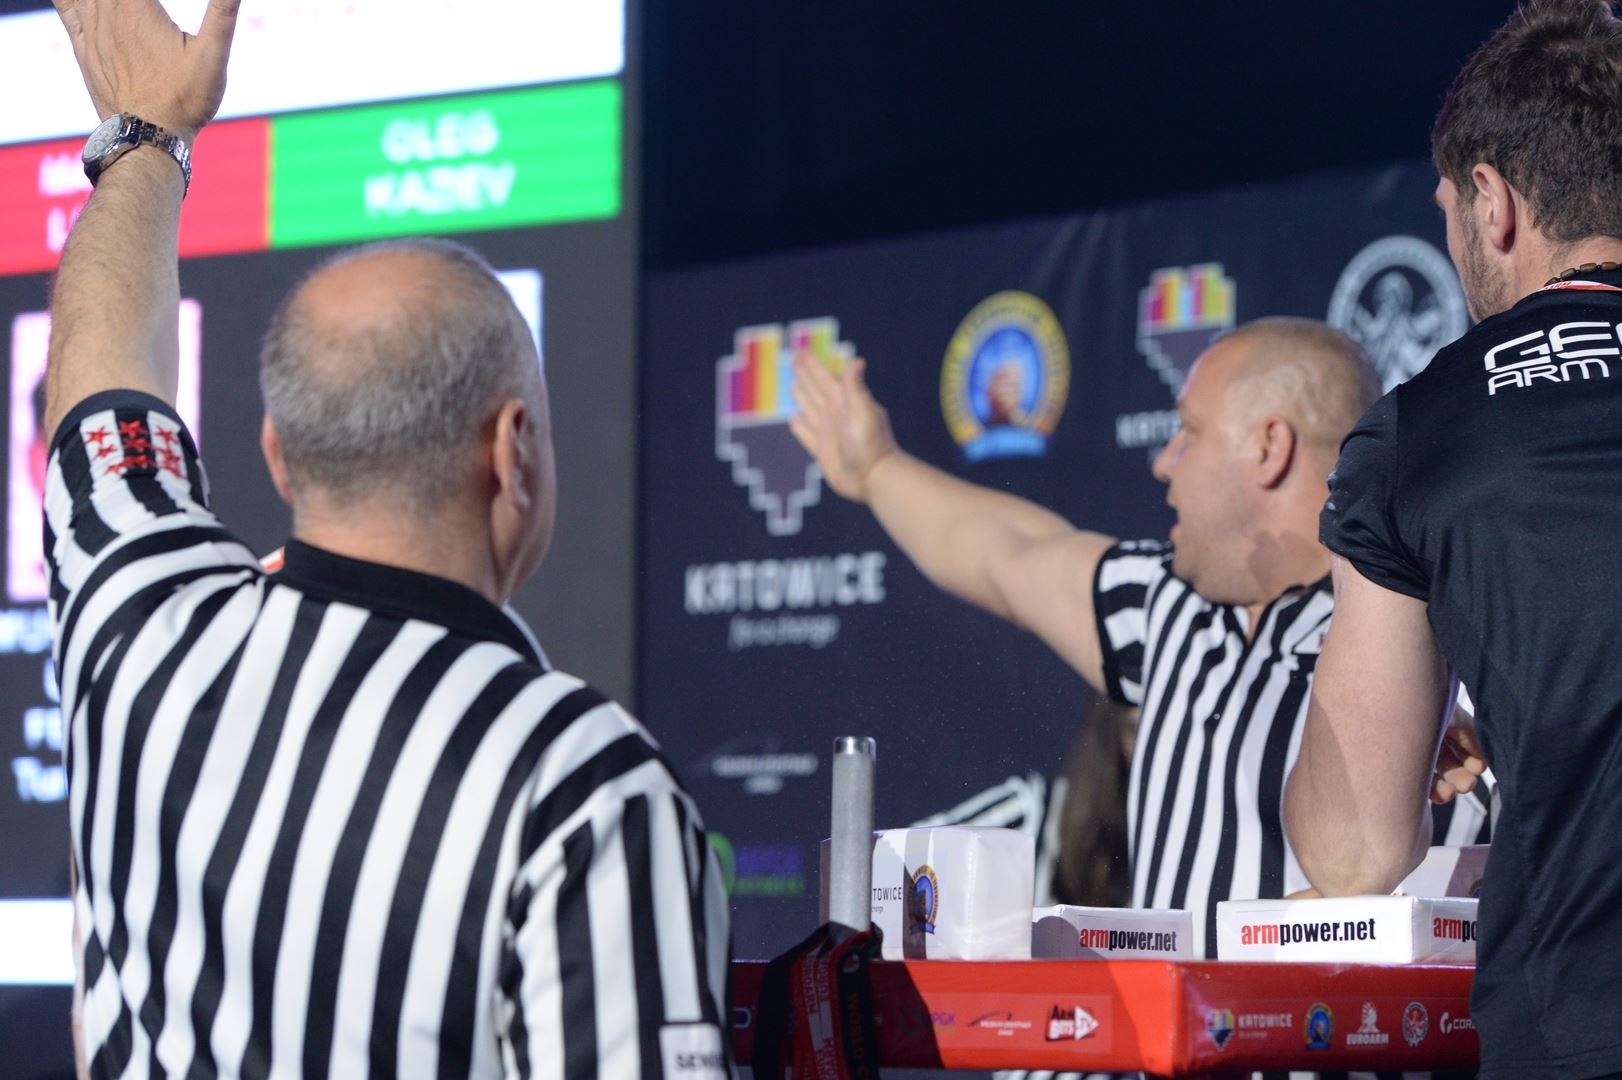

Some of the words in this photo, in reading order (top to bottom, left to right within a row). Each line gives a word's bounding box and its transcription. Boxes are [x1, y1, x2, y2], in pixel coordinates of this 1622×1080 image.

[1484, 322, 1622, 373] GE
[1488, 358, 1610, 395] ARM
[684, 551, 887, 614] KATOWICE
[872, 886, 903, 901] TOWICE
[1080, 928, 1177, 952] armpower.net
[1241, 917, 1376, 946] armpower.net
[1433, 917, 1476, 943] armpo
[1238, 1013, 1293, 1029] KATOWICE
[1453, 1018, 1477, 1030] COR
[1346, 1033, 1390, 1046] EUROARM
